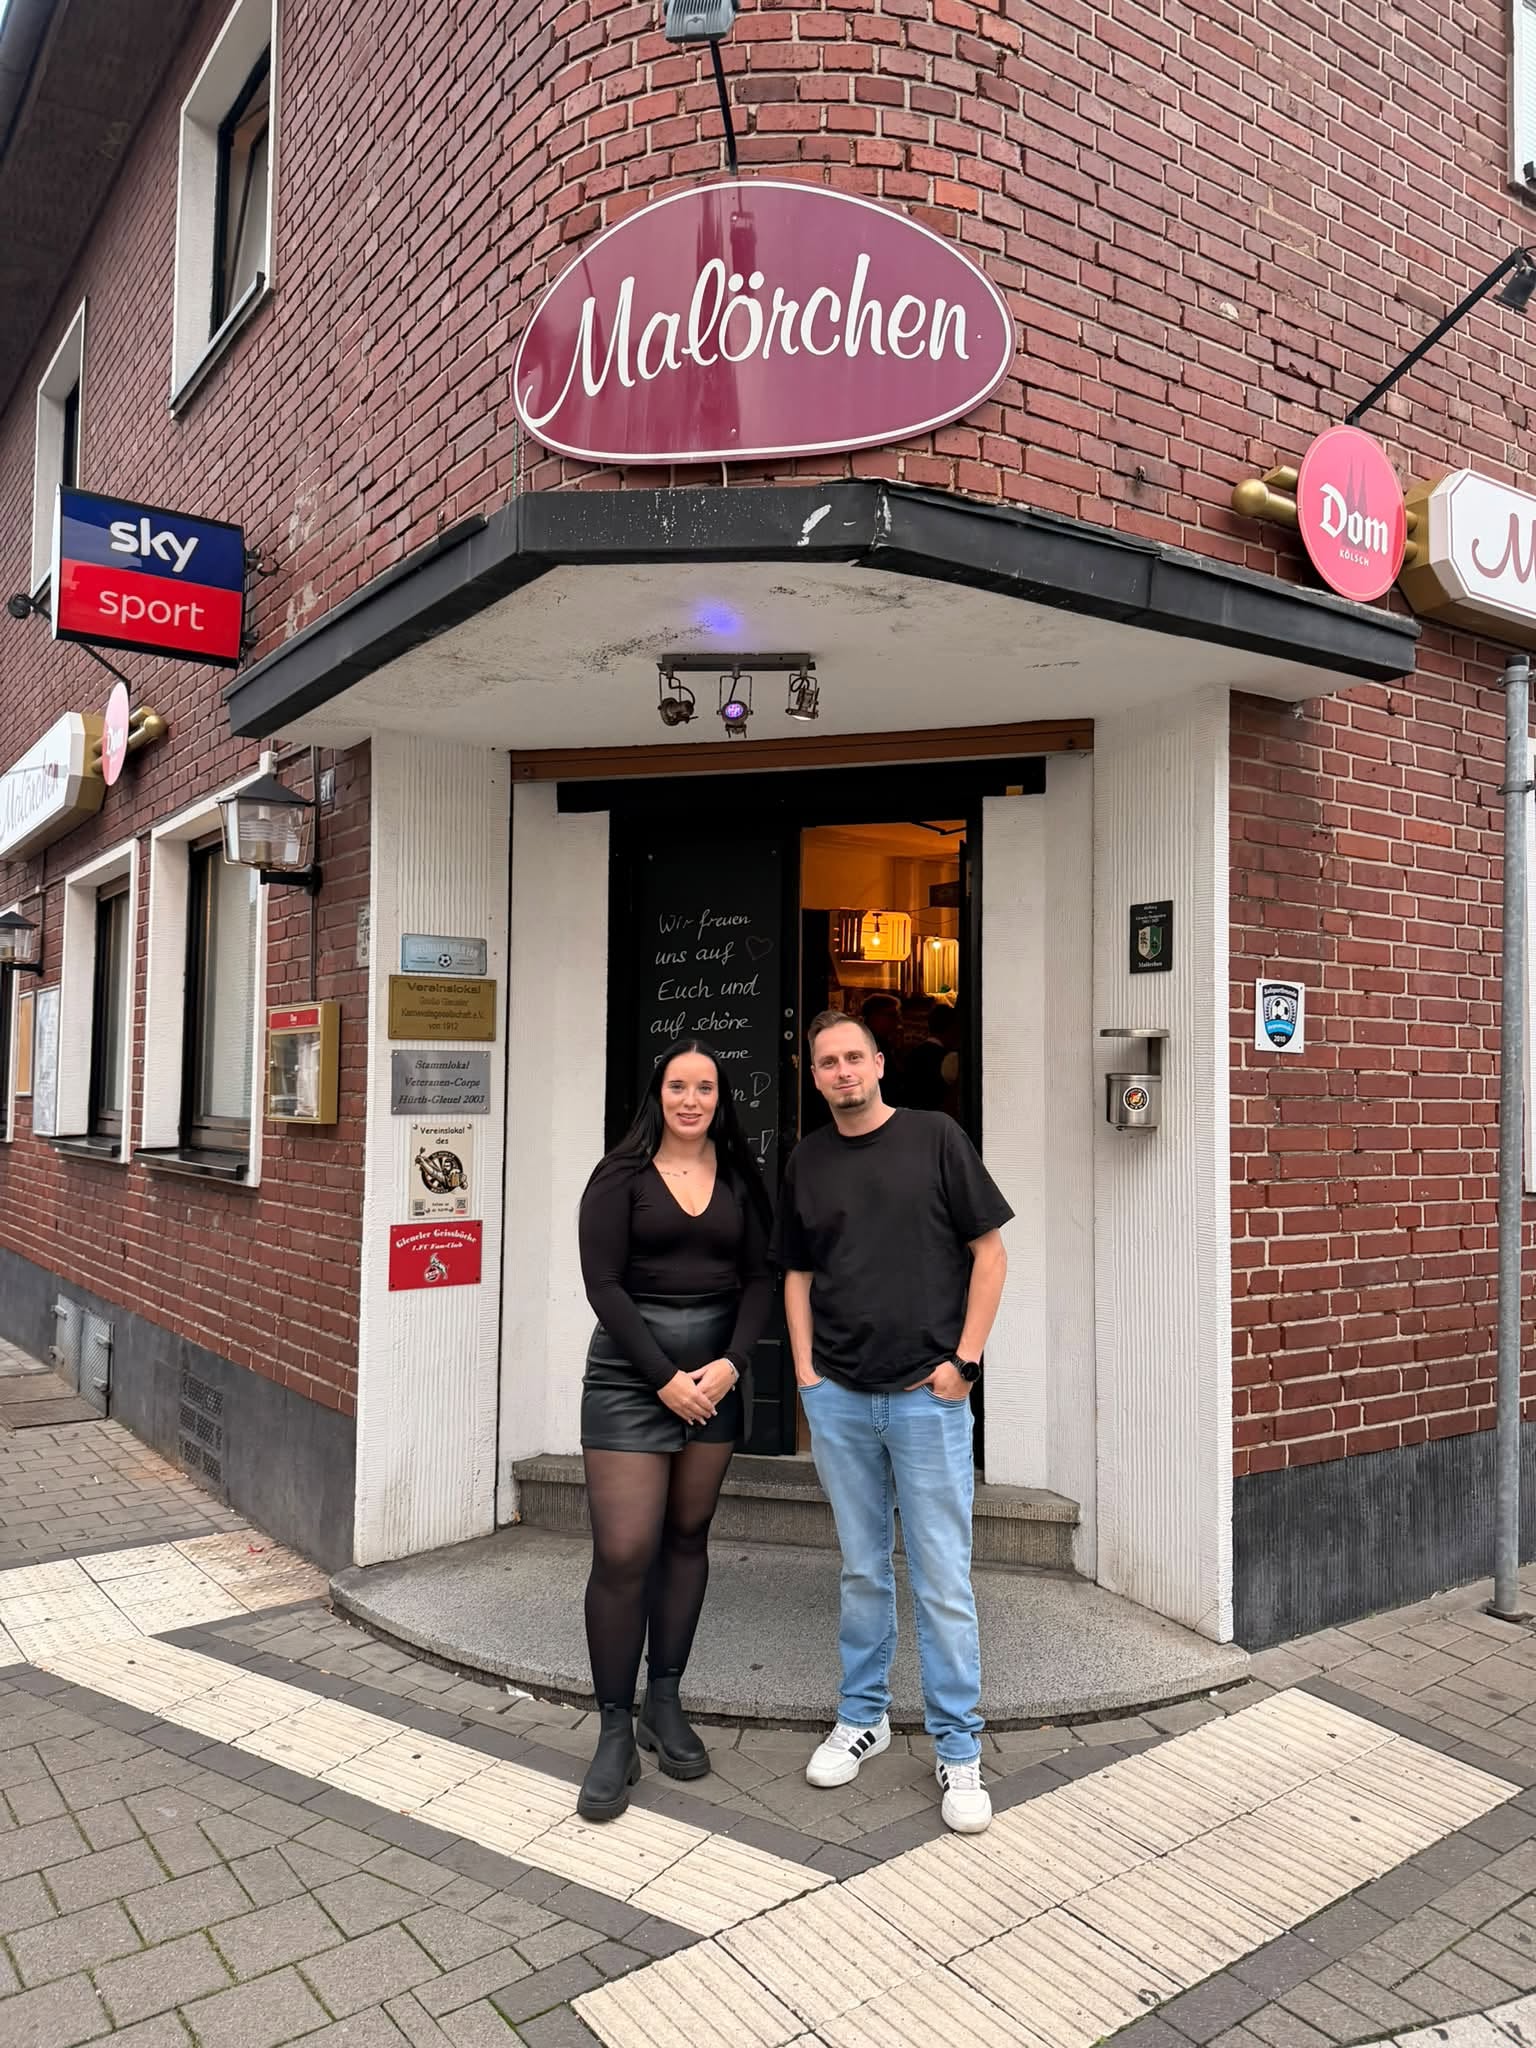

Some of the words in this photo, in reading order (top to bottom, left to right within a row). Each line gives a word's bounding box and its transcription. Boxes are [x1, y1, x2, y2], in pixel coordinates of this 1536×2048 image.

[523, 252, 970, 428] Malörchen
[1319, 482, 1389, 556] Dom
[109, 517, 199, 573] sky
[1338, 547, 1370, 568] KÖLSCH
[98, 589, 205, 632] sport
[658, 912, 695, 934] Wir
[696, 908, 752, 941] freuen
[655, 950, 688, 965] uns
[695, 941, 736, 966] auf
[407, 982, 481, 994] Vereinslokal
[657, 977, 714, 1001] Euch
[720, 973, 761, 997] und
[650, 1010, 686, 1040] auf
[691, 1010, 753, 1031] schöne
[415, 1060, 470, 1070] Stammlokal
[405, 1077, 481, 1089] Veteranen-Corps
[398, 1095, 461, 1105] Hürth-Gleuel
[462, 1095, 485, 1104] 2003
[420, 1126, 465, 1135] Vereinslokal
[435, 1137, 449, 1145] des
[395, 1231, 431, 1249] Gleueler
